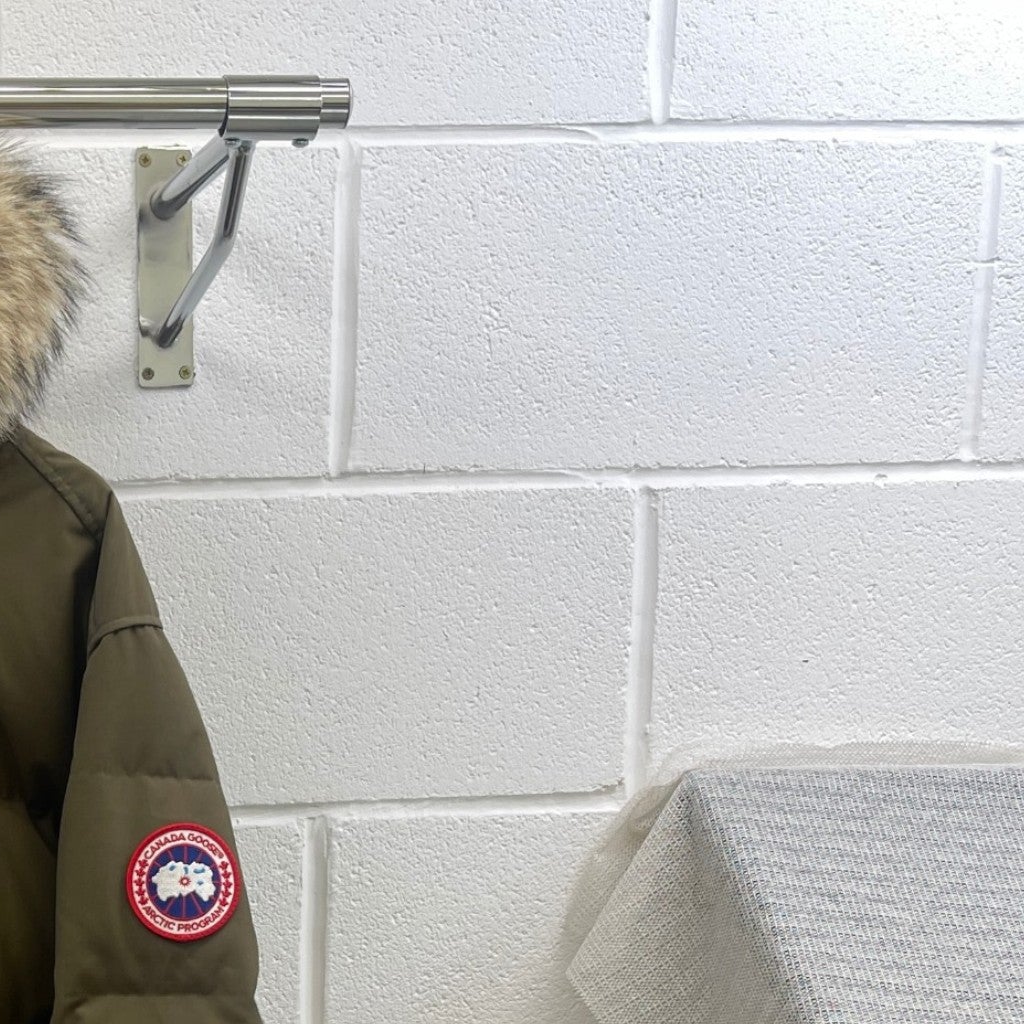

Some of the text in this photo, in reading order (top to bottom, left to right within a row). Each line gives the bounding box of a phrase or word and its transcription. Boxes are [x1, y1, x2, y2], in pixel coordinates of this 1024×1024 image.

[144, 832, 186, 860] CANADA
[142, 905, 225, 932] ARCTIC PROGRAM
